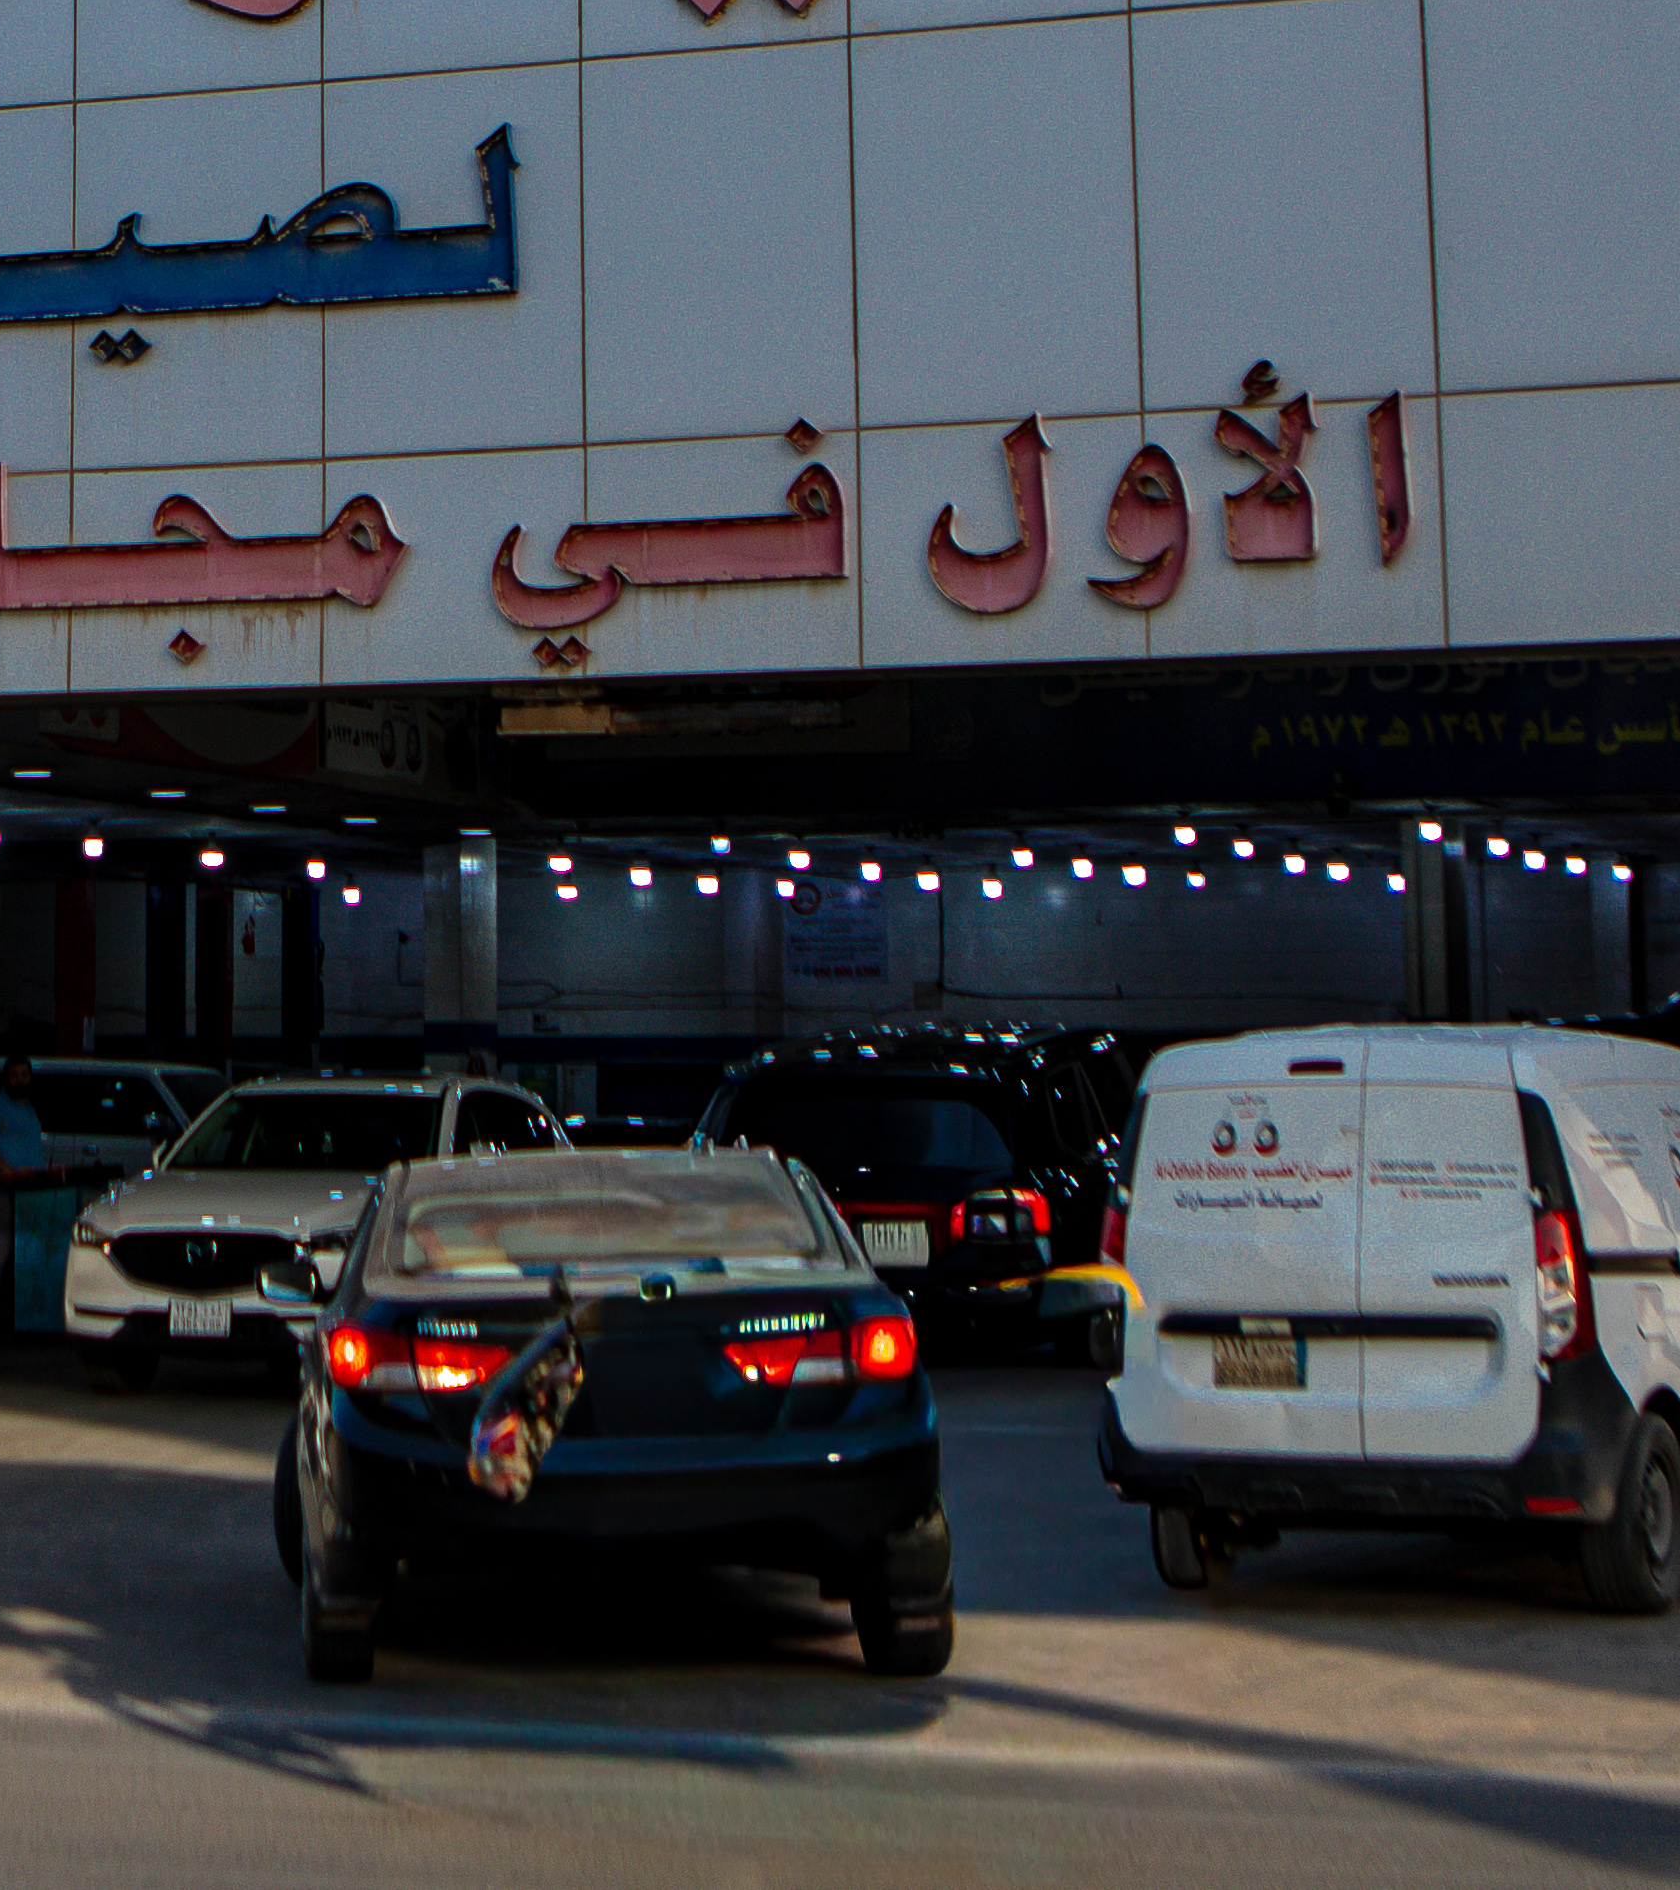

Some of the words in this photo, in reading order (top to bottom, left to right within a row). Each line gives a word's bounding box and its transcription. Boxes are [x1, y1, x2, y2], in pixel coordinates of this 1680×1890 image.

[490, 415, 852, 670] في
[926, 359, 1413, 614] الأول
[1519, 707, 1588, 756] عام
